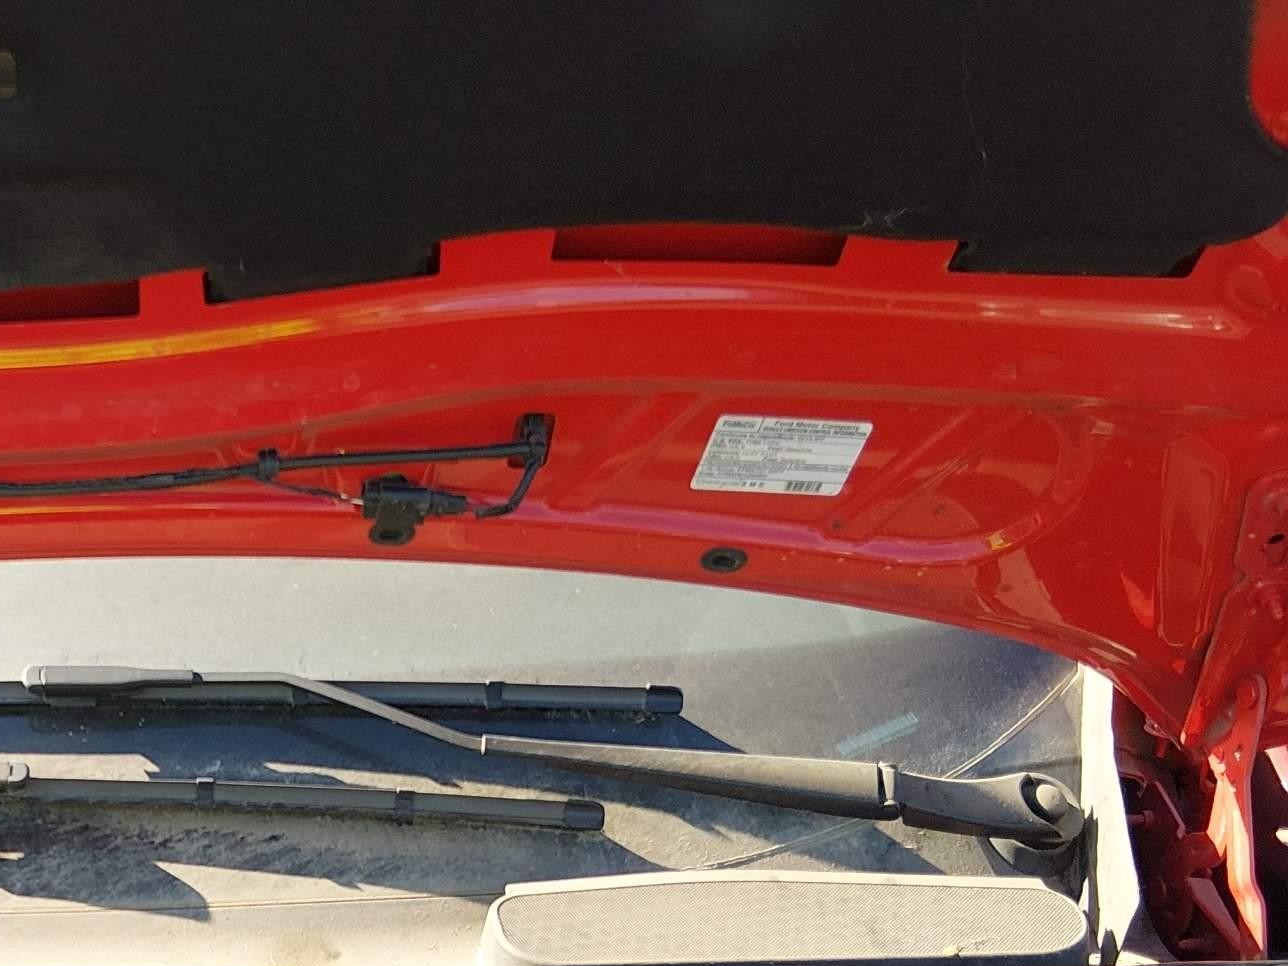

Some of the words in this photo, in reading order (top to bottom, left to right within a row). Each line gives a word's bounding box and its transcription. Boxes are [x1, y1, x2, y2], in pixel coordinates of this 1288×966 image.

[774, 420, 795, 428] Ford
[796, 421, 819, 429] Motor
[821, 423, 861, 432] Company
